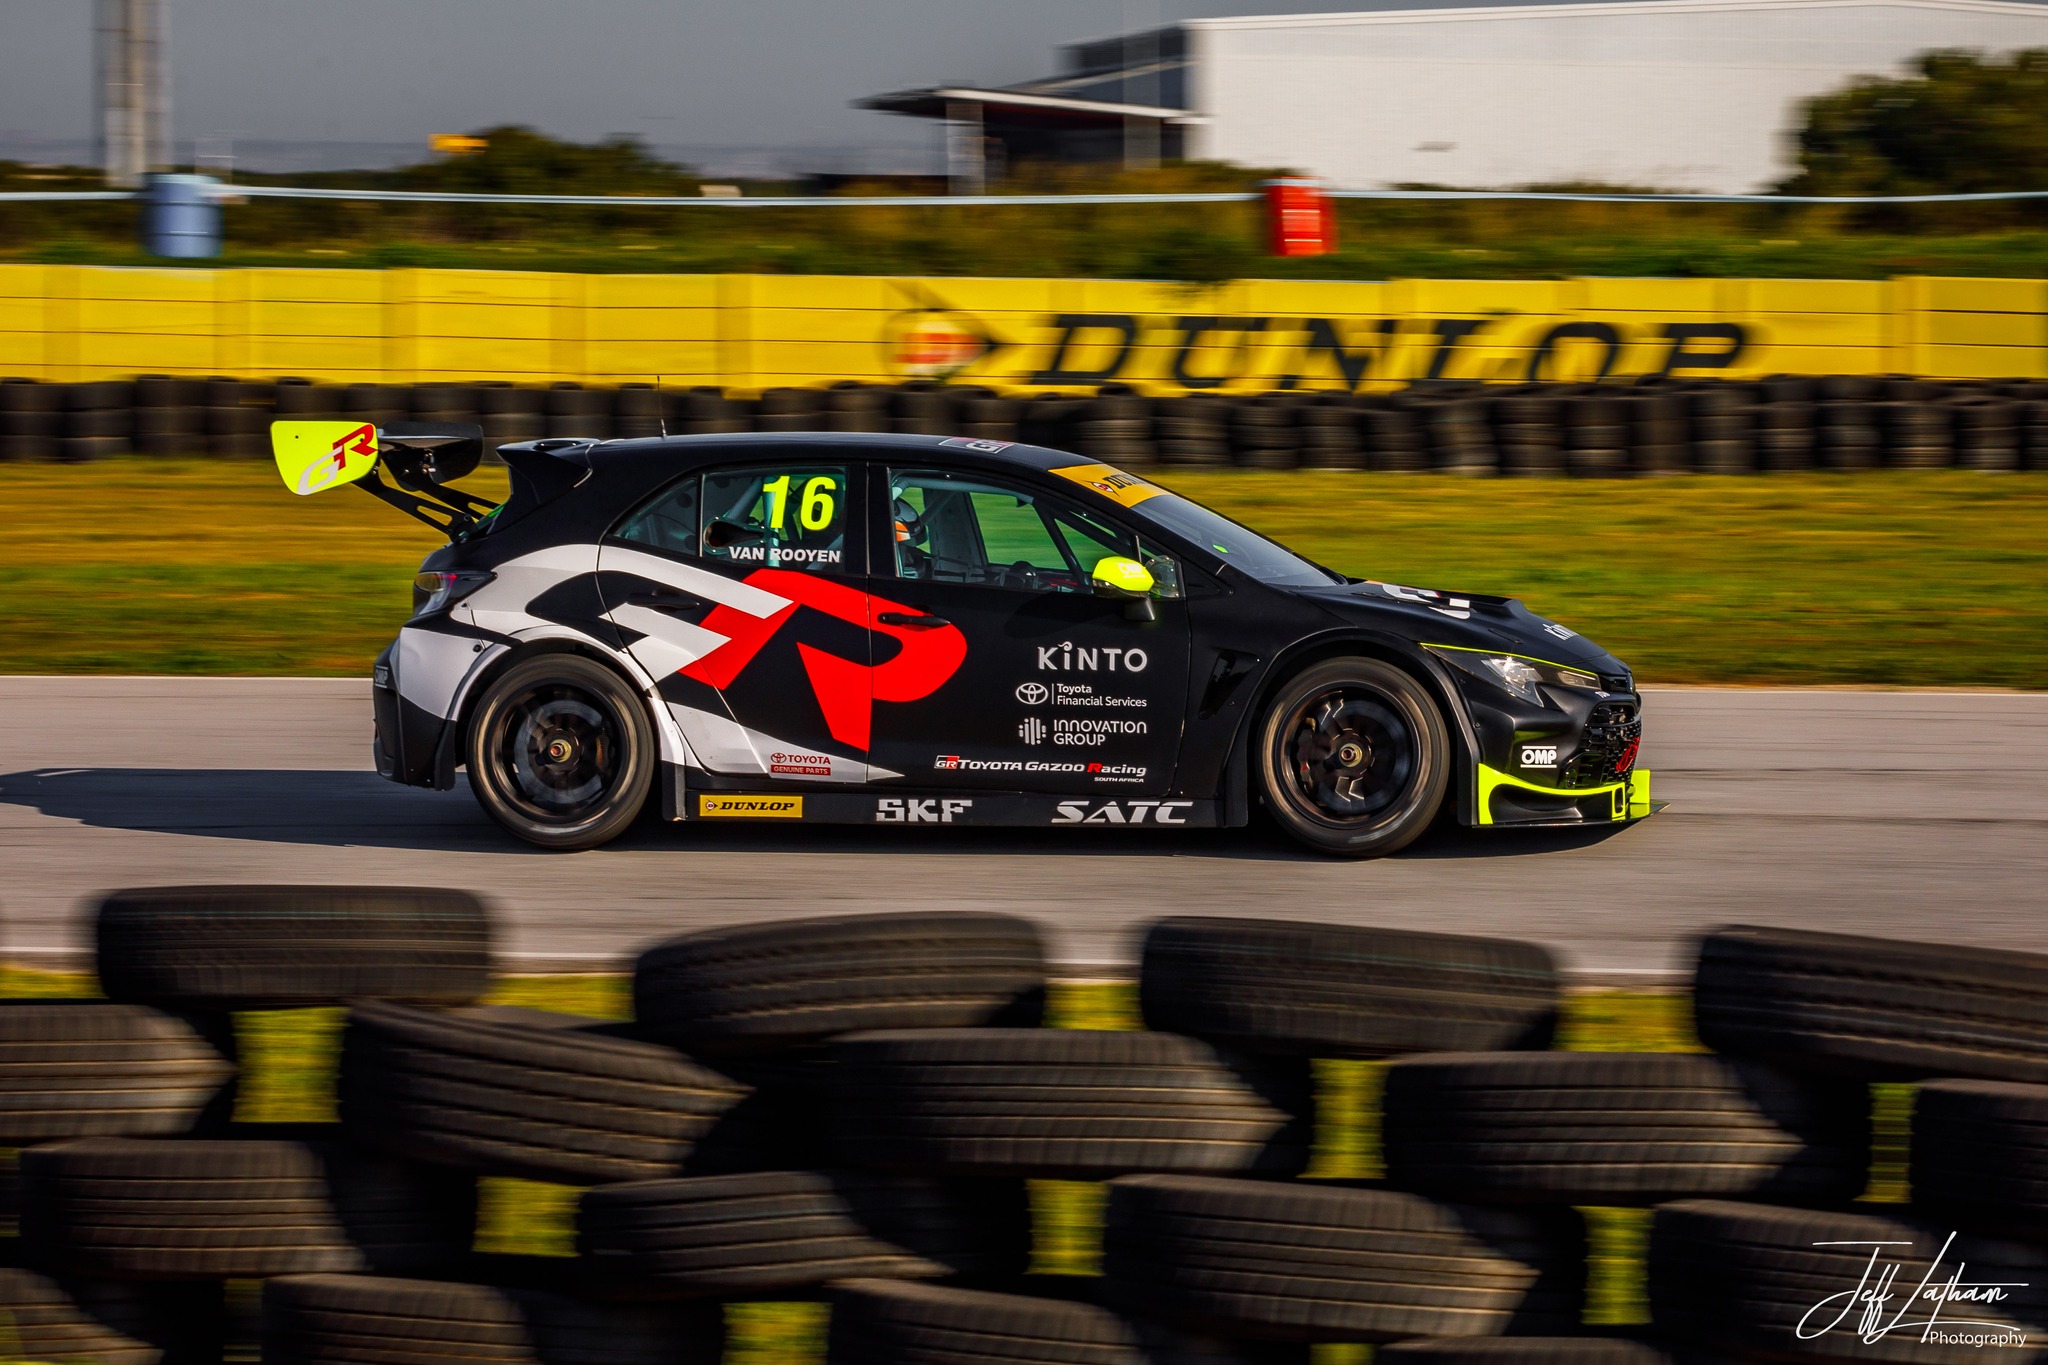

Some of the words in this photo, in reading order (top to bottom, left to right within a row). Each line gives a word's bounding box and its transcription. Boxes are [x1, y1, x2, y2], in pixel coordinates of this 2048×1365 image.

[1030, 311, 1751, 390] DUNLOP
[297, 424, 377, 496] GR
[762, 475, 837, 531] 16
[729, 546, 765, 561] VAN
[769, 547, 841, 563] ROOYEN
[1057, 683, 1092, 695] Toyota
[1057, 695, 1104, 706] Financial
[1105, 696, 1147, 708] Services
[1053, 733, 1106, 746] GROUP
[788, 754, 831, 765] TOYOTA
[1520, 748, 1557, 765] OMP
[773, 766, 804, 774] GENUINE
[806, 767, 828, 775] PARTS
[957, 759, 1023, 771] TOYOTA
[1025, 761, 1085, 772] GAZOO
[1087, 762, 1147, 777] Racing
[719, 801, 795, 811] DUNLOP
[876, 799, 973, 822] SKF
[1051, 800, 1194, 824] SATC
